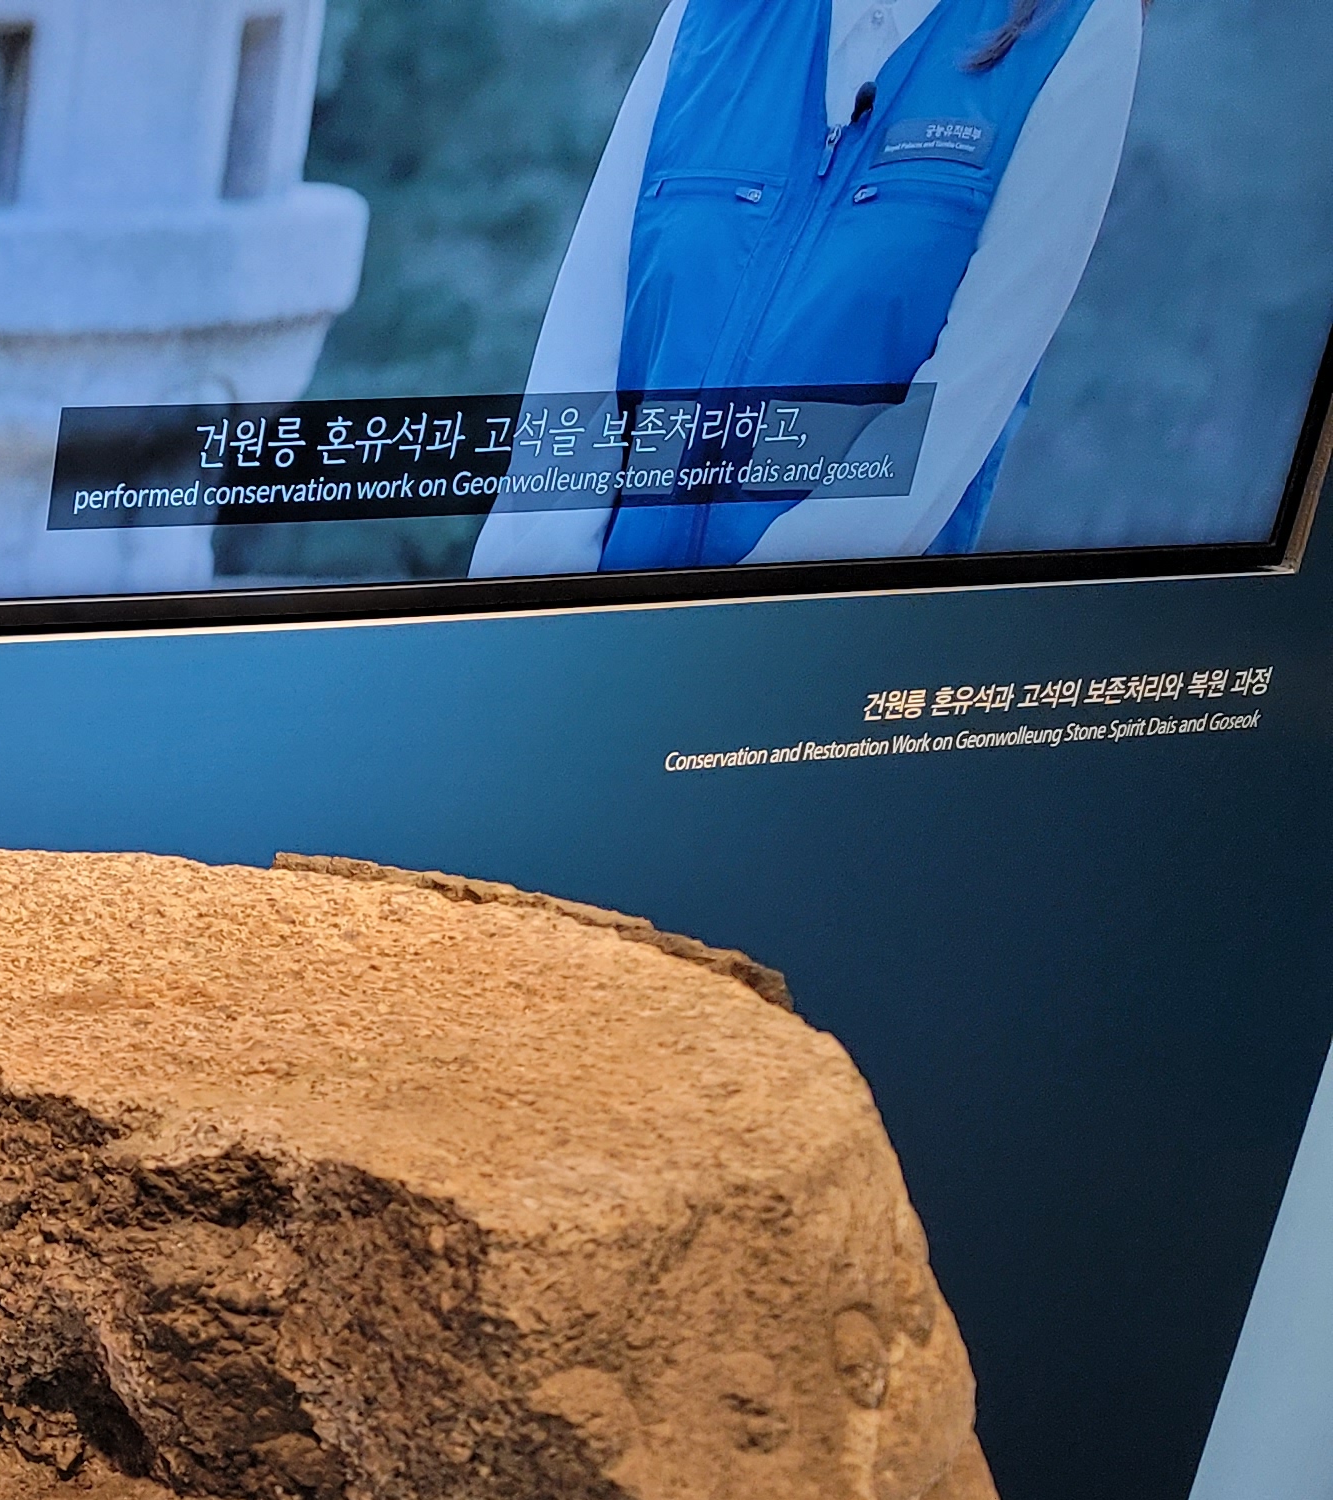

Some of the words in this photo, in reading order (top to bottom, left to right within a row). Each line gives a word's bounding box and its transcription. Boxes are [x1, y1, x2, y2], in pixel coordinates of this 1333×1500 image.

[197, 417, 306, 468] 건원릉
[317, 411, 466, 465] 혼유석과
[474, 406, 586, 456] 고석을
[592, 401, 808, 454] 보존처리하고,
[73, 481, 199, 514] performed
[203, 477, 351, 505] conservation
[357, 473, 413, 499] work
[418, 474, 447, 497] on
[453, 466, 611, 496] Geonwolleung
[612, 466, 674, 489] stone
[677, 460, 734, 488] spirit
[738, 457, 786, 483] dais
[783, 457, 823, 482] and
[822, 455, 894, 484] goseok.
[863, 688, 926, 721] 건원릉
[931, 683, 1014, 716] 혼유석과
[1017, 679, 1082, 708] 고석의
[1083, 672, 1183, 704] 보존처리와
[1187, 669, 1229, 698] 복원
[1230, 666, 1273, 696] 과정
[665, 746, 767, 771] Conservation
[770, 742, 802, 763] and
[802, 737, 889, 761] Restoration
[892, 732, 931, 755] Work
[933, 735, 953, 751] on
[955, 726, 1063, 749] Geonwolleung
[1064, 723, 1106, 741] Stone
[1108, 718, 1145, 743] Spirit
[1148, 716, 1178, 735] Dais
[1178, 713, 1206, 732] and
[1209, 709, 1261, 730] Goseok
